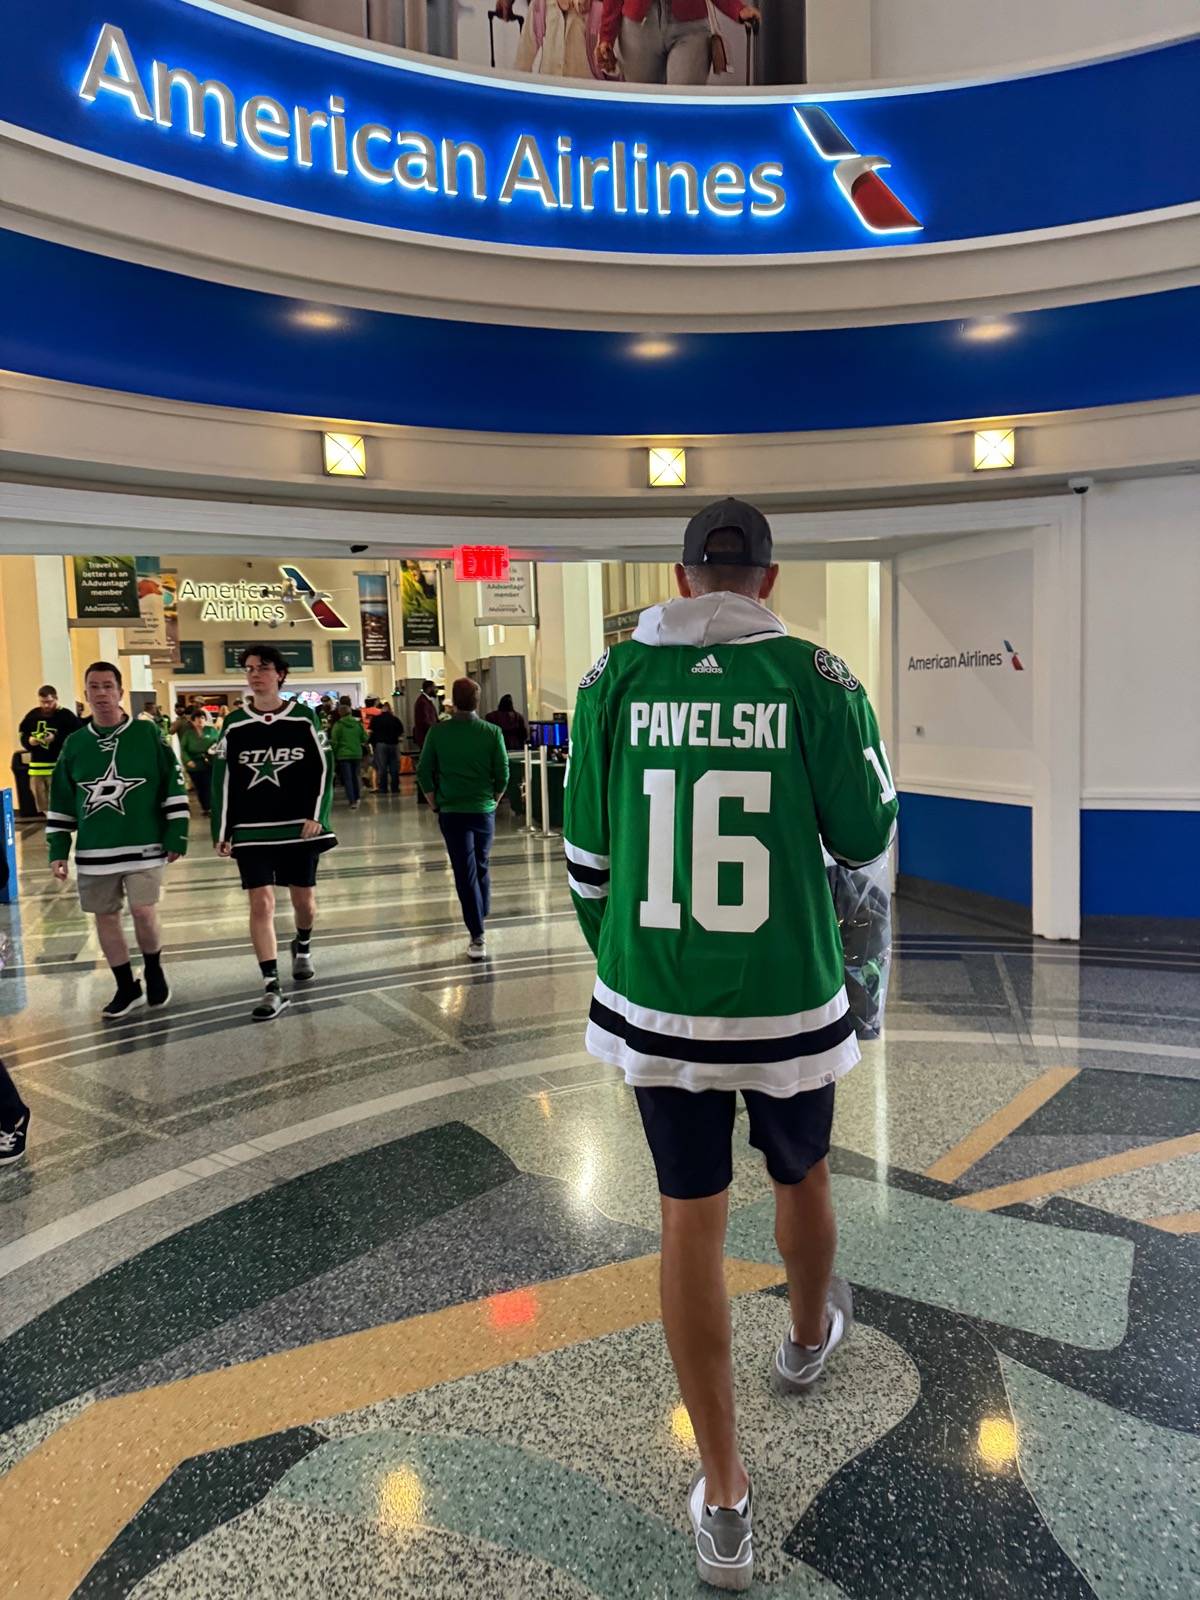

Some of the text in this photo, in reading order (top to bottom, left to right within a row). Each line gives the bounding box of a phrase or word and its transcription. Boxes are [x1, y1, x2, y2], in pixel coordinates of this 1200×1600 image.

[79, 22, 787, 217] American Airlines
[201, 600, 287, 621] Airlines
[691, 666, 723, 674] adidas
[908, 651, 1003, 671] American Airlines
[630, 702, 787, 749] PAVELSKI
[238, 746, 306, 765] STARS
[639, 769, 772, 933] 16
